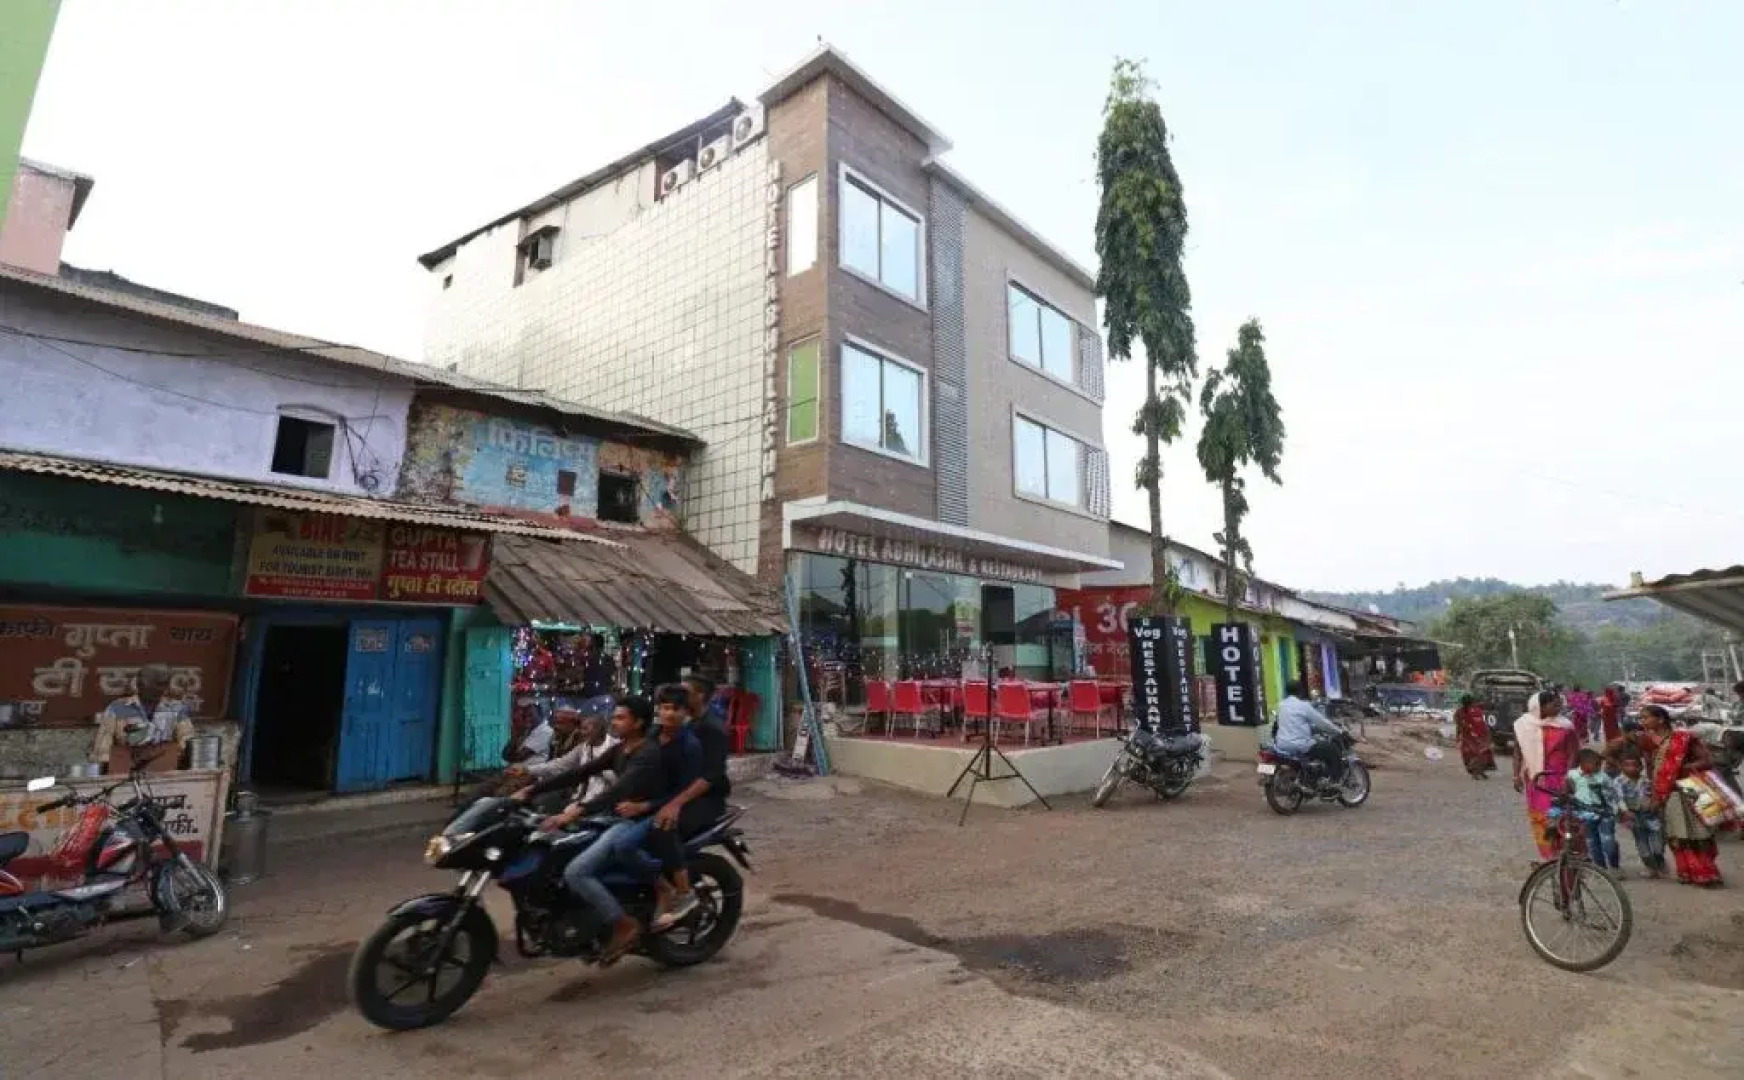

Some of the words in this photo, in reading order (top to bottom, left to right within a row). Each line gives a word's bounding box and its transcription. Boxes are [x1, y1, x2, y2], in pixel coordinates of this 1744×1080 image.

[390, 527, 459, 550] GUPTA
[818, 527, 878, 559] HOTEL
[388, 549, 417, 570] TEA
[420, 551, 459, 572] STALL
[62, 622, 157, 658] गुप्ता
[1134, 626, 1161, 640] Veg
[33, 657, 89, 699] टी
[1142, 640, 1161, 733] RESTAURANT
[1176, 639, 1192, 732] RESTAURANT
[1220, 627, 1245, 723] HOTEL
[1250, 626, 1266, 721] HOTEL
